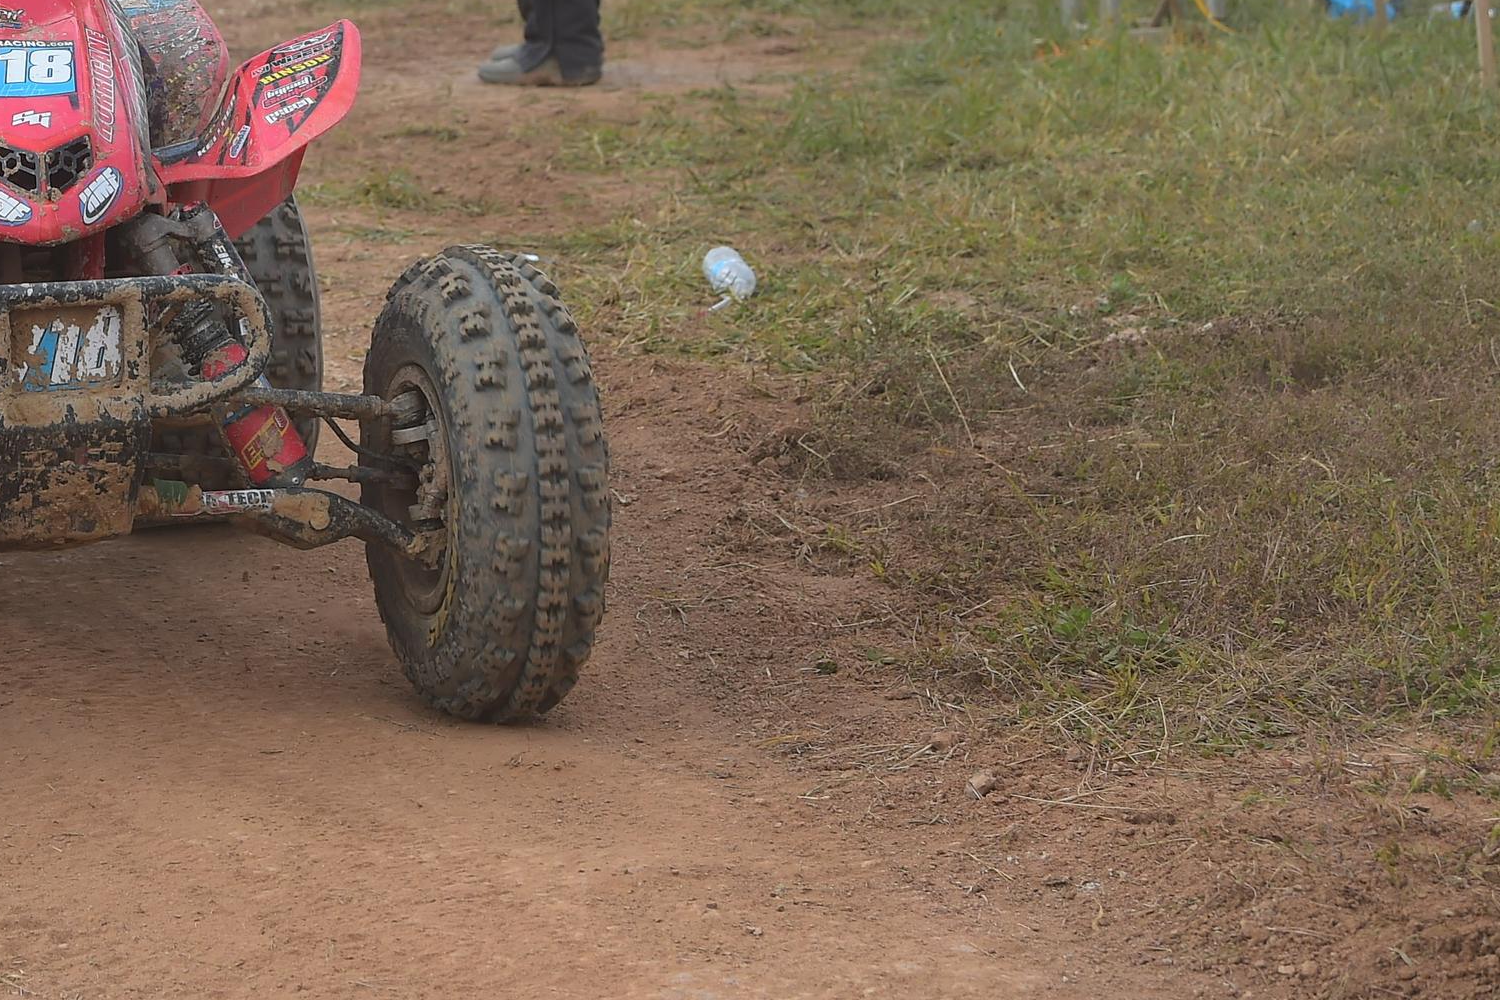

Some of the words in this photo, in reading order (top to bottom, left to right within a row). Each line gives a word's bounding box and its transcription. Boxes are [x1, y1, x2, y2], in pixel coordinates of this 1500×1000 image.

[85, 28, 116, 143] HURRICANE
[259, 53, 333, 85] HINSON
[212, 243, 239, 279] Elk
[16, 305, 123, 387] 18
